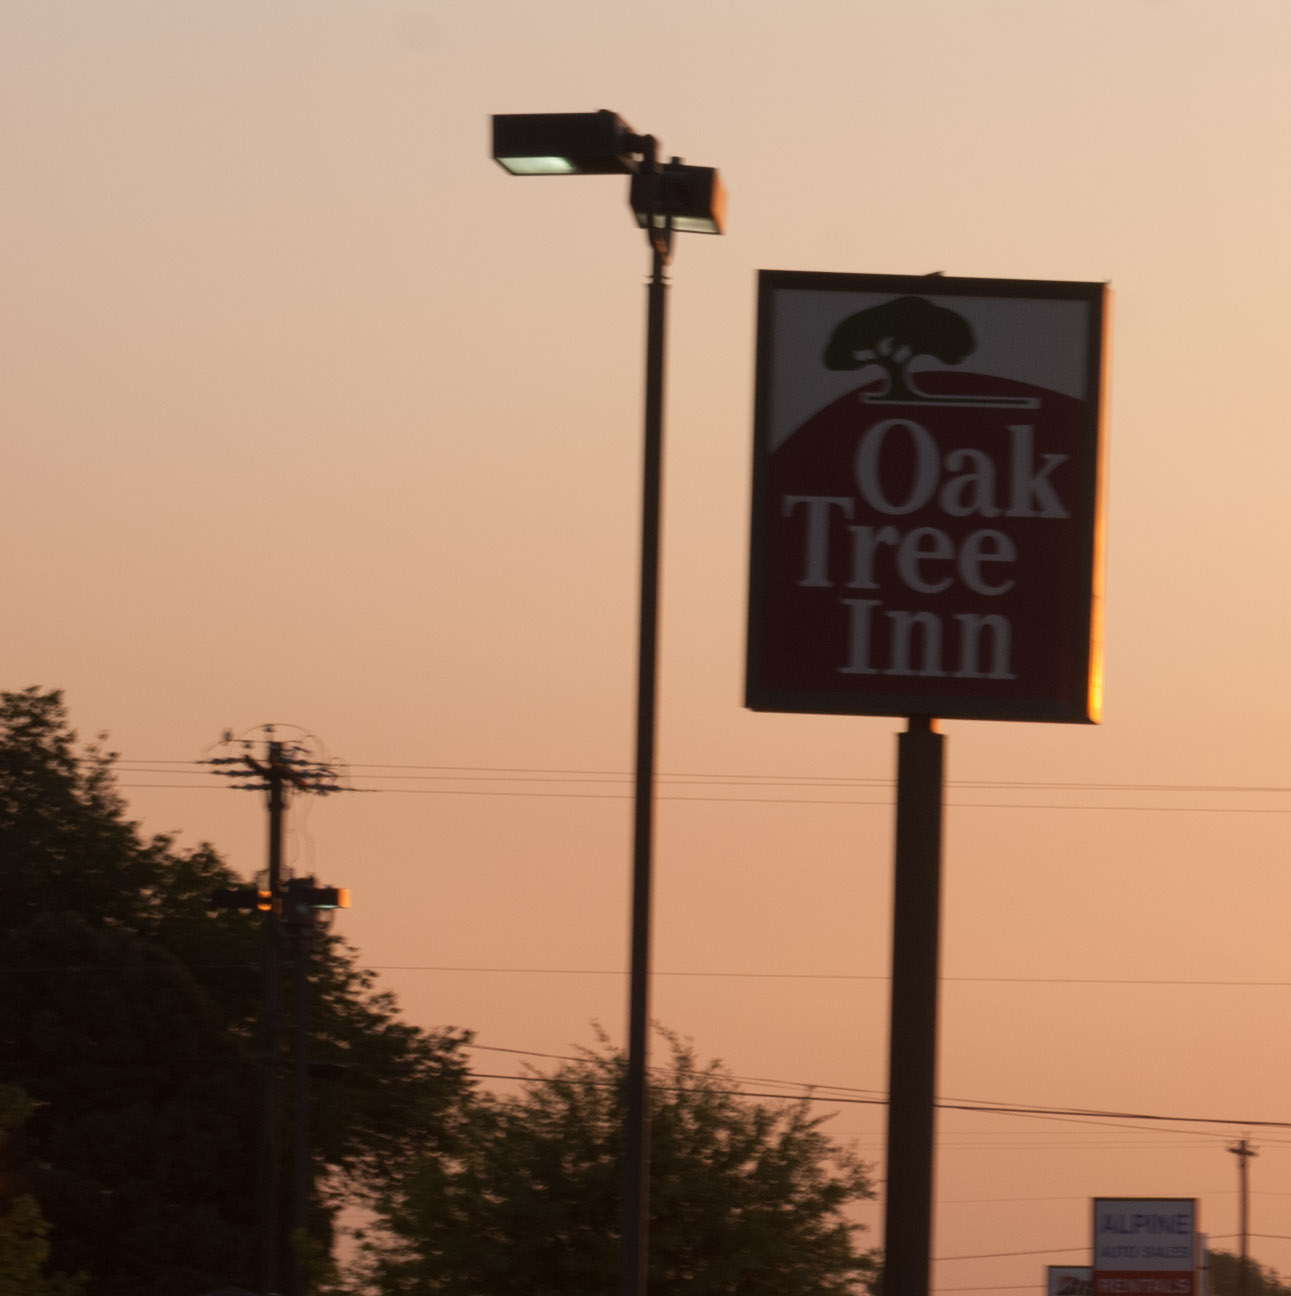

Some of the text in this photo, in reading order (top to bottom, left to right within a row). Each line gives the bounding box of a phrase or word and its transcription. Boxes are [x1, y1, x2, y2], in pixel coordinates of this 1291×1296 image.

[854, 418, 1071, 519] Oak
[781, 494, 1018, 596] Tree
[838, 598, 1017, 681] Inn
[1101, 1213, 1191, 1235] ALPINE
[1101, 1245, 1192, 1260] AUTO SALES
[1097, 1278, 1192, 1294] RENTALS
